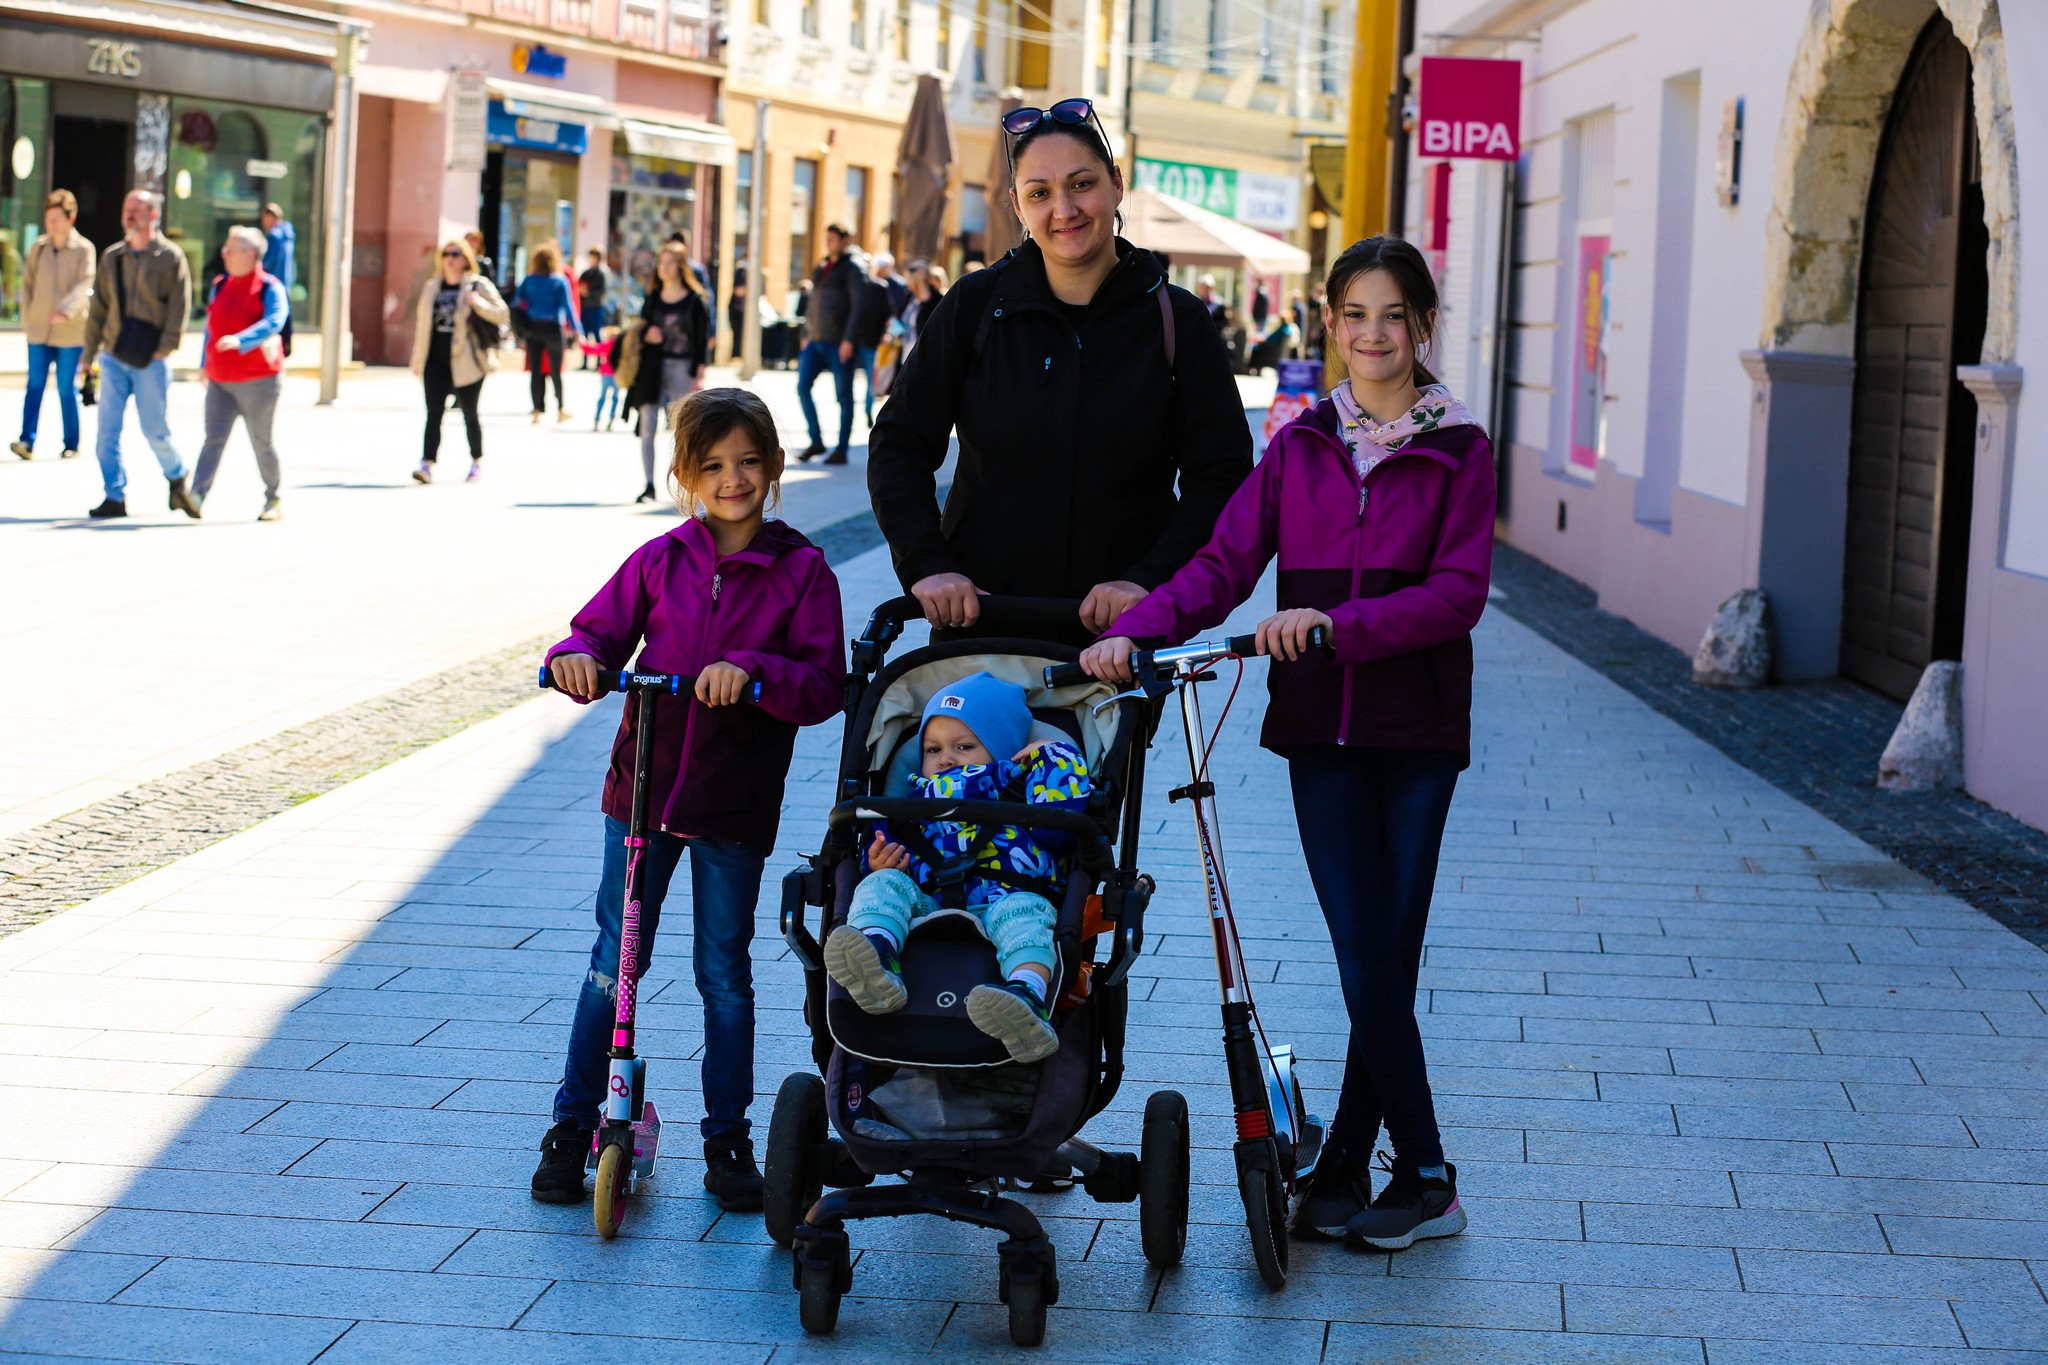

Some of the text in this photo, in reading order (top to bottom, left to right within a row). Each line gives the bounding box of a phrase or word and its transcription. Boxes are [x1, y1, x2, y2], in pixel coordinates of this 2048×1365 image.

[1425, 120, 1514, 155] BIPA
[1134, 159, 1229, 210] MODA
[1204, 851, 1219, 911] FIREFLY
